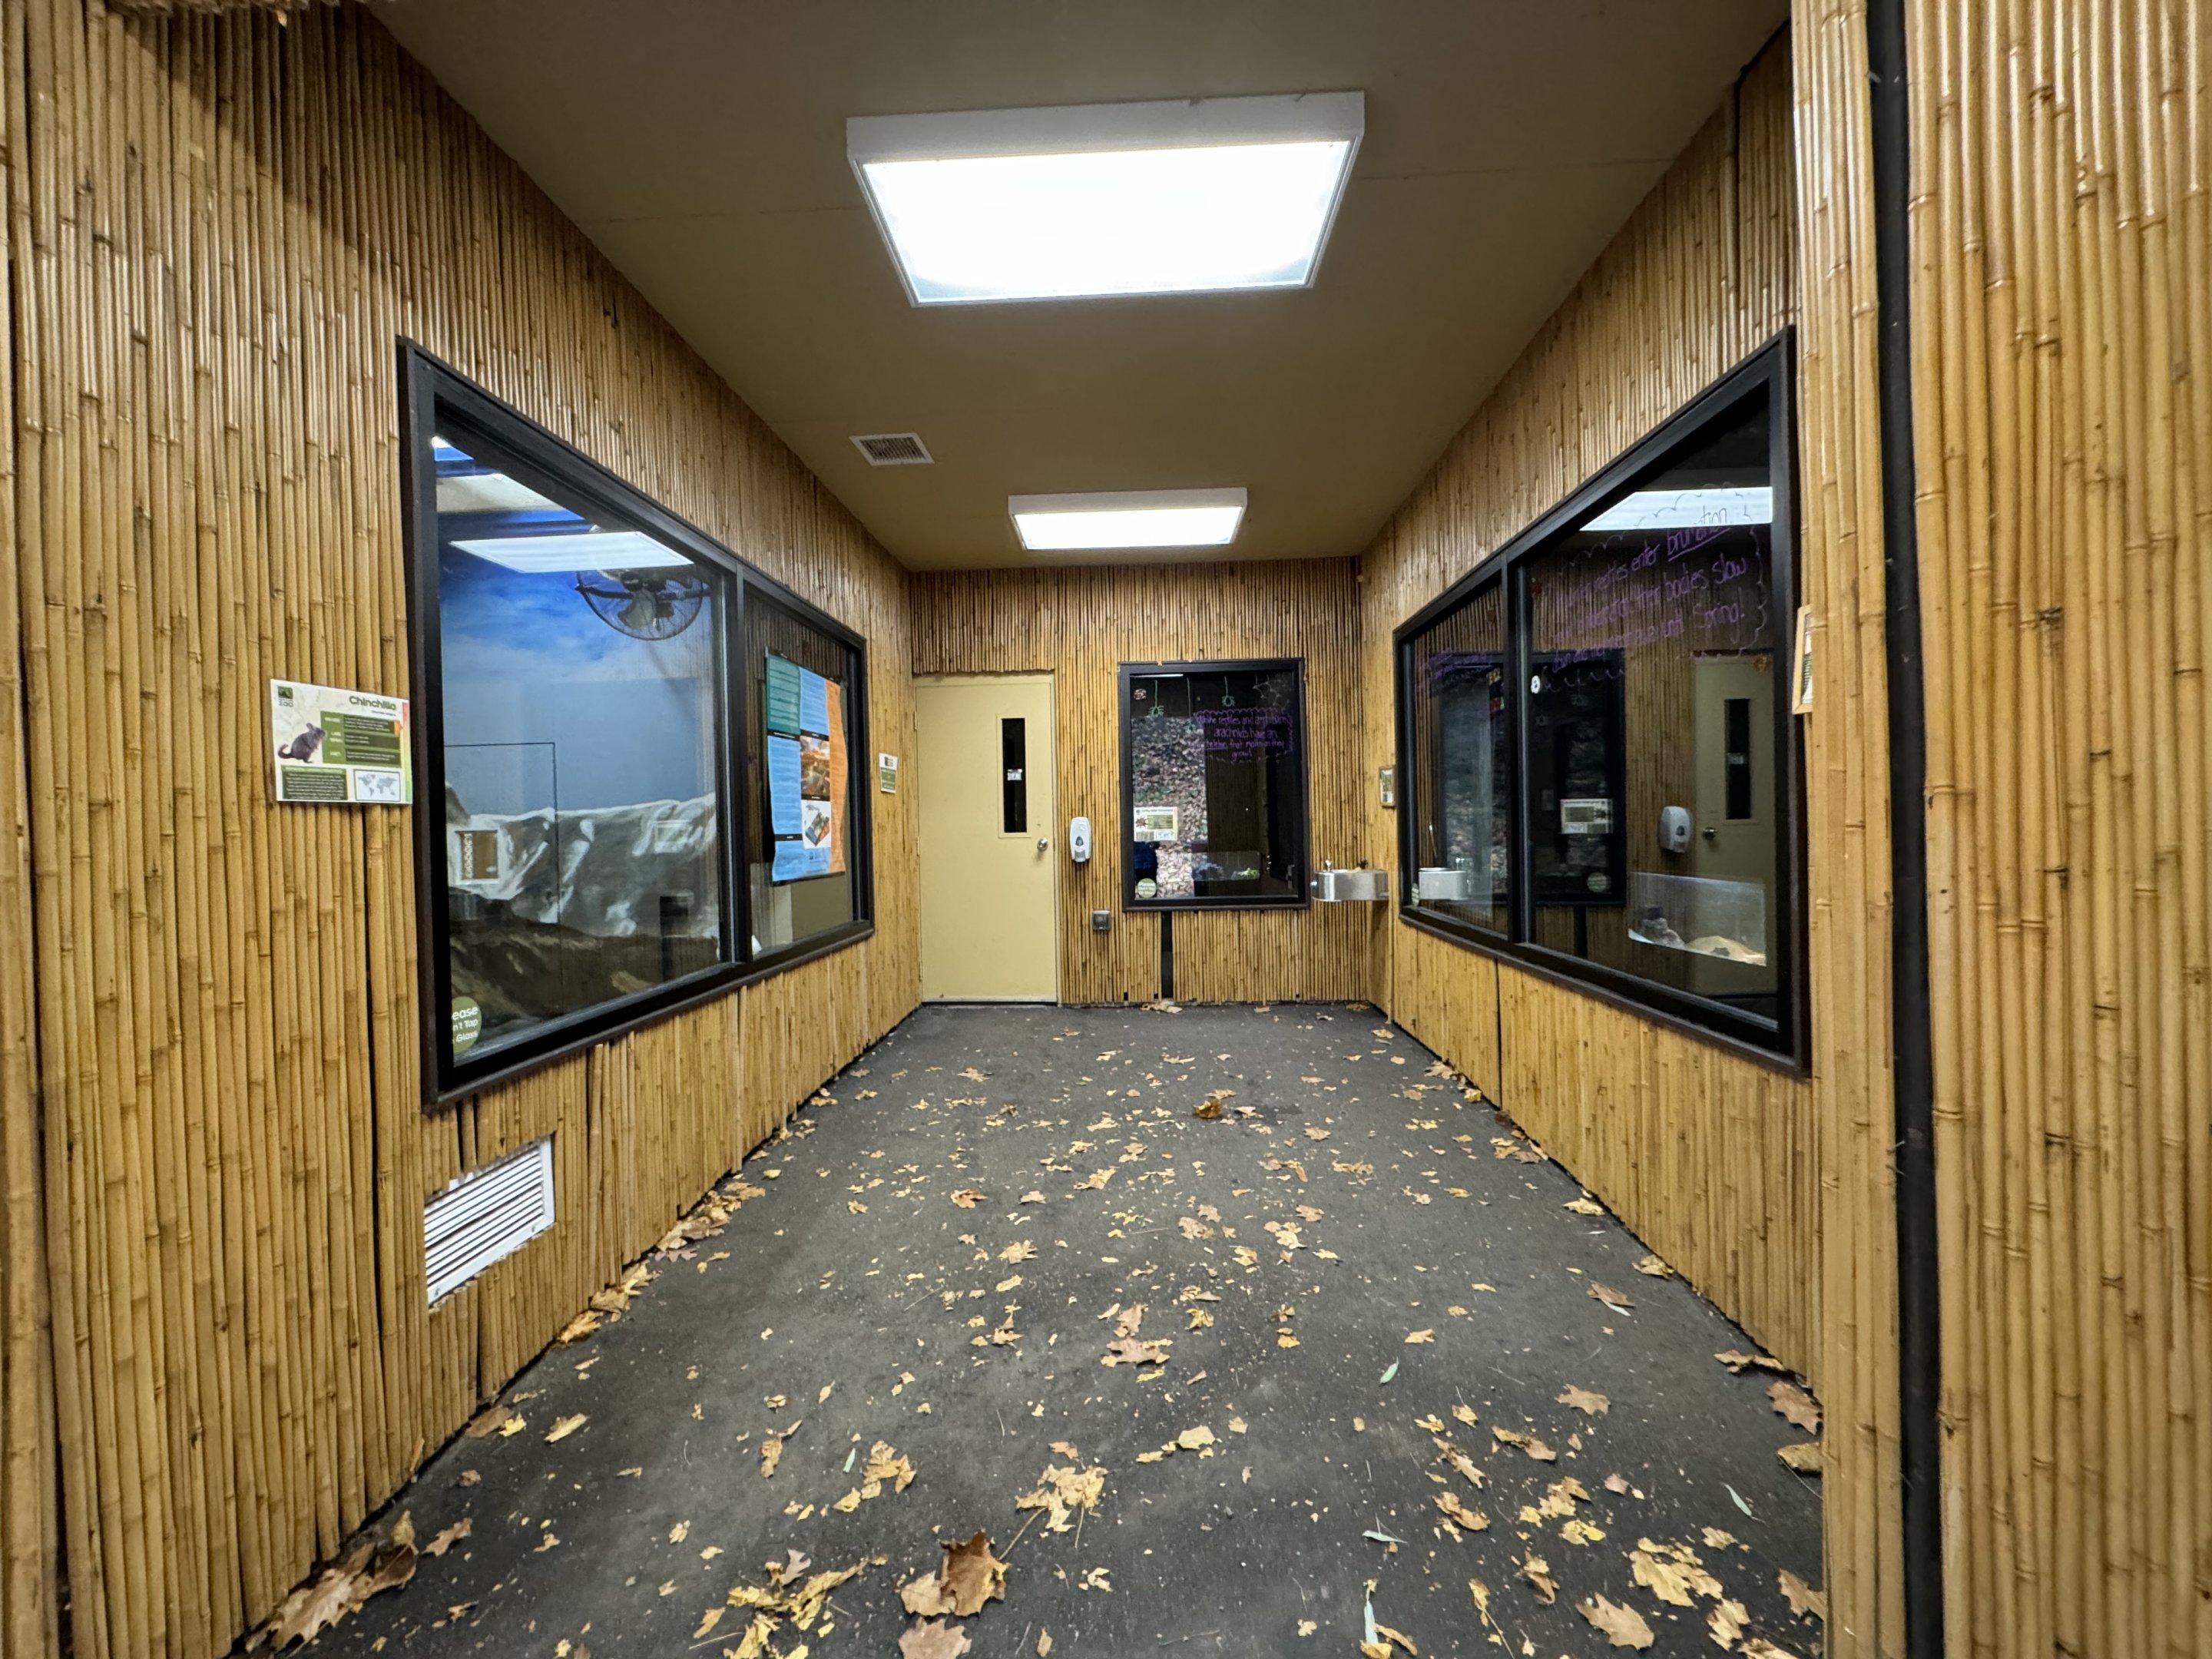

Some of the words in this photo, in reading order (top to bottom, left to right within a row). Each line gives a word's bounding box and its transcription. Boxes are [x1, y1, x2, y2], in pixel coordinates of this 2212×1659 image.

[1631, 538, 1661, 572] enter
[1663, 562, 1709, 601] bodies
[349, 695, 396, 710] Chinchilla
[463, 1019, 478, 1028] Tap
[455, 1031, 478, 1042] Glass
